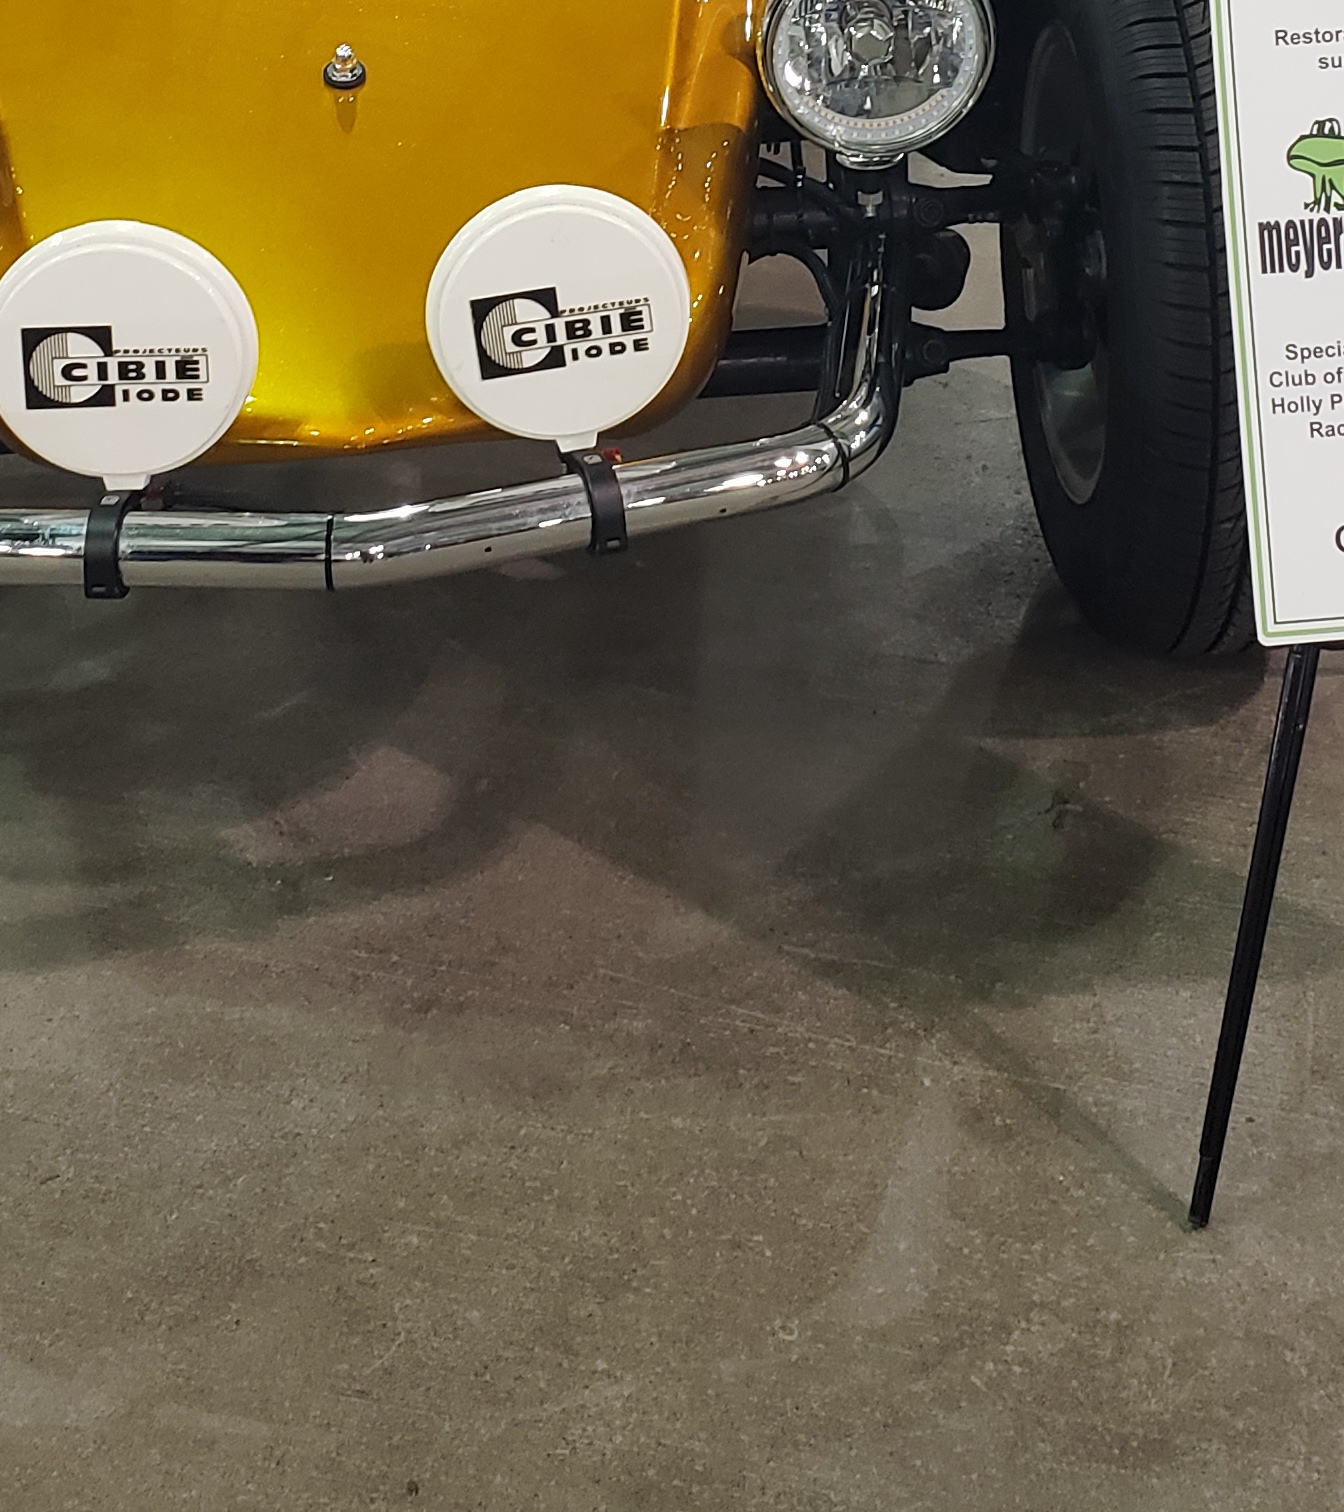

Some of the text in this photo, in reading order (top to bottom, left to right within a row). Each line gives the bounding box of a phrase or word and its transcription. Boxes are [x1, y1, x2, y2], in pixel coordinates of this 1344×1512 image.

[571, 337, 651, 362] IODE
[1268, 368, 1318, 389] Club
[1322, 365, 1344, 386] of
[121, 387, 205, 403] IODE
[1270, 394, 1324, 418] Holly
